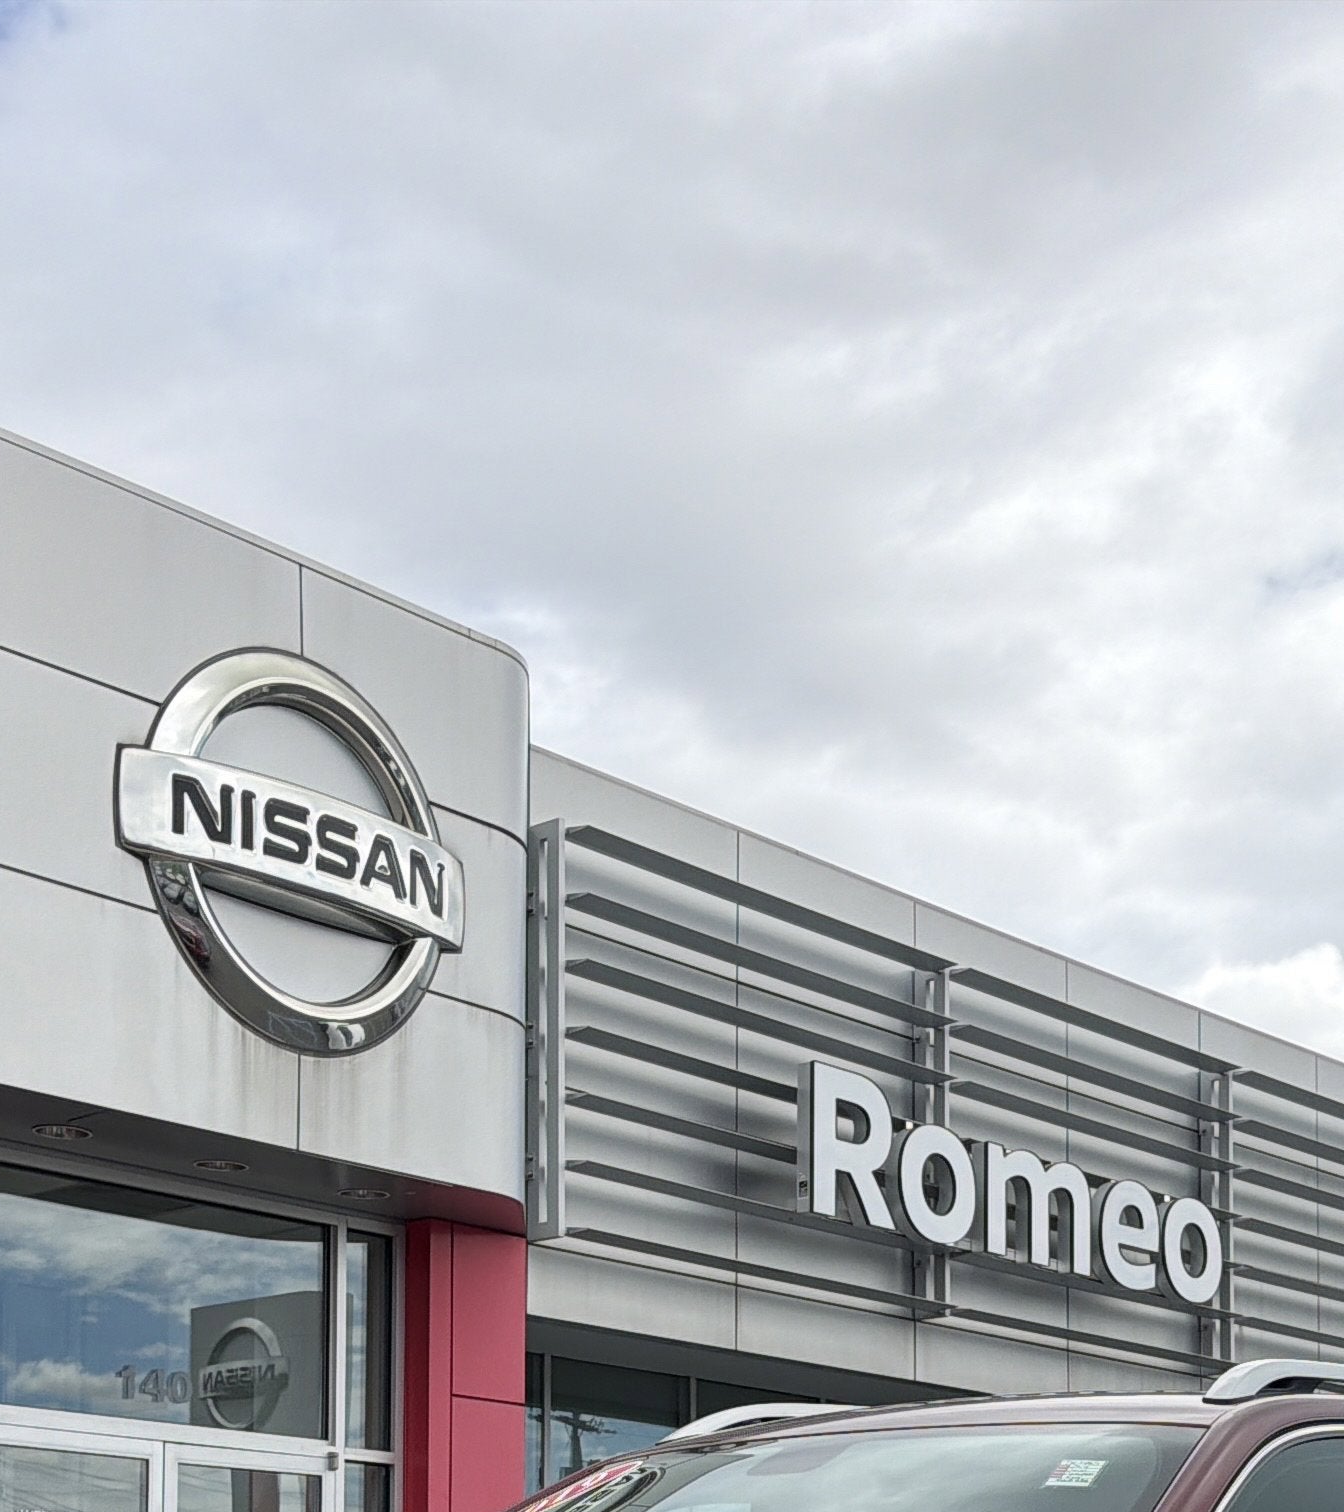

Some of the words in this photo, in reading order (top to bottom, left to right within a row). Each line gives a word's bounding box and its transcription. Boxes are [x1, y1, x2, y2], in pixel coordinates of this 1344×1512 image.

[170, 773, 446, 919] NISSAN
[806, 1060, 1223, 1304] Romeo
[115, 1365, 191, 1404] 140
